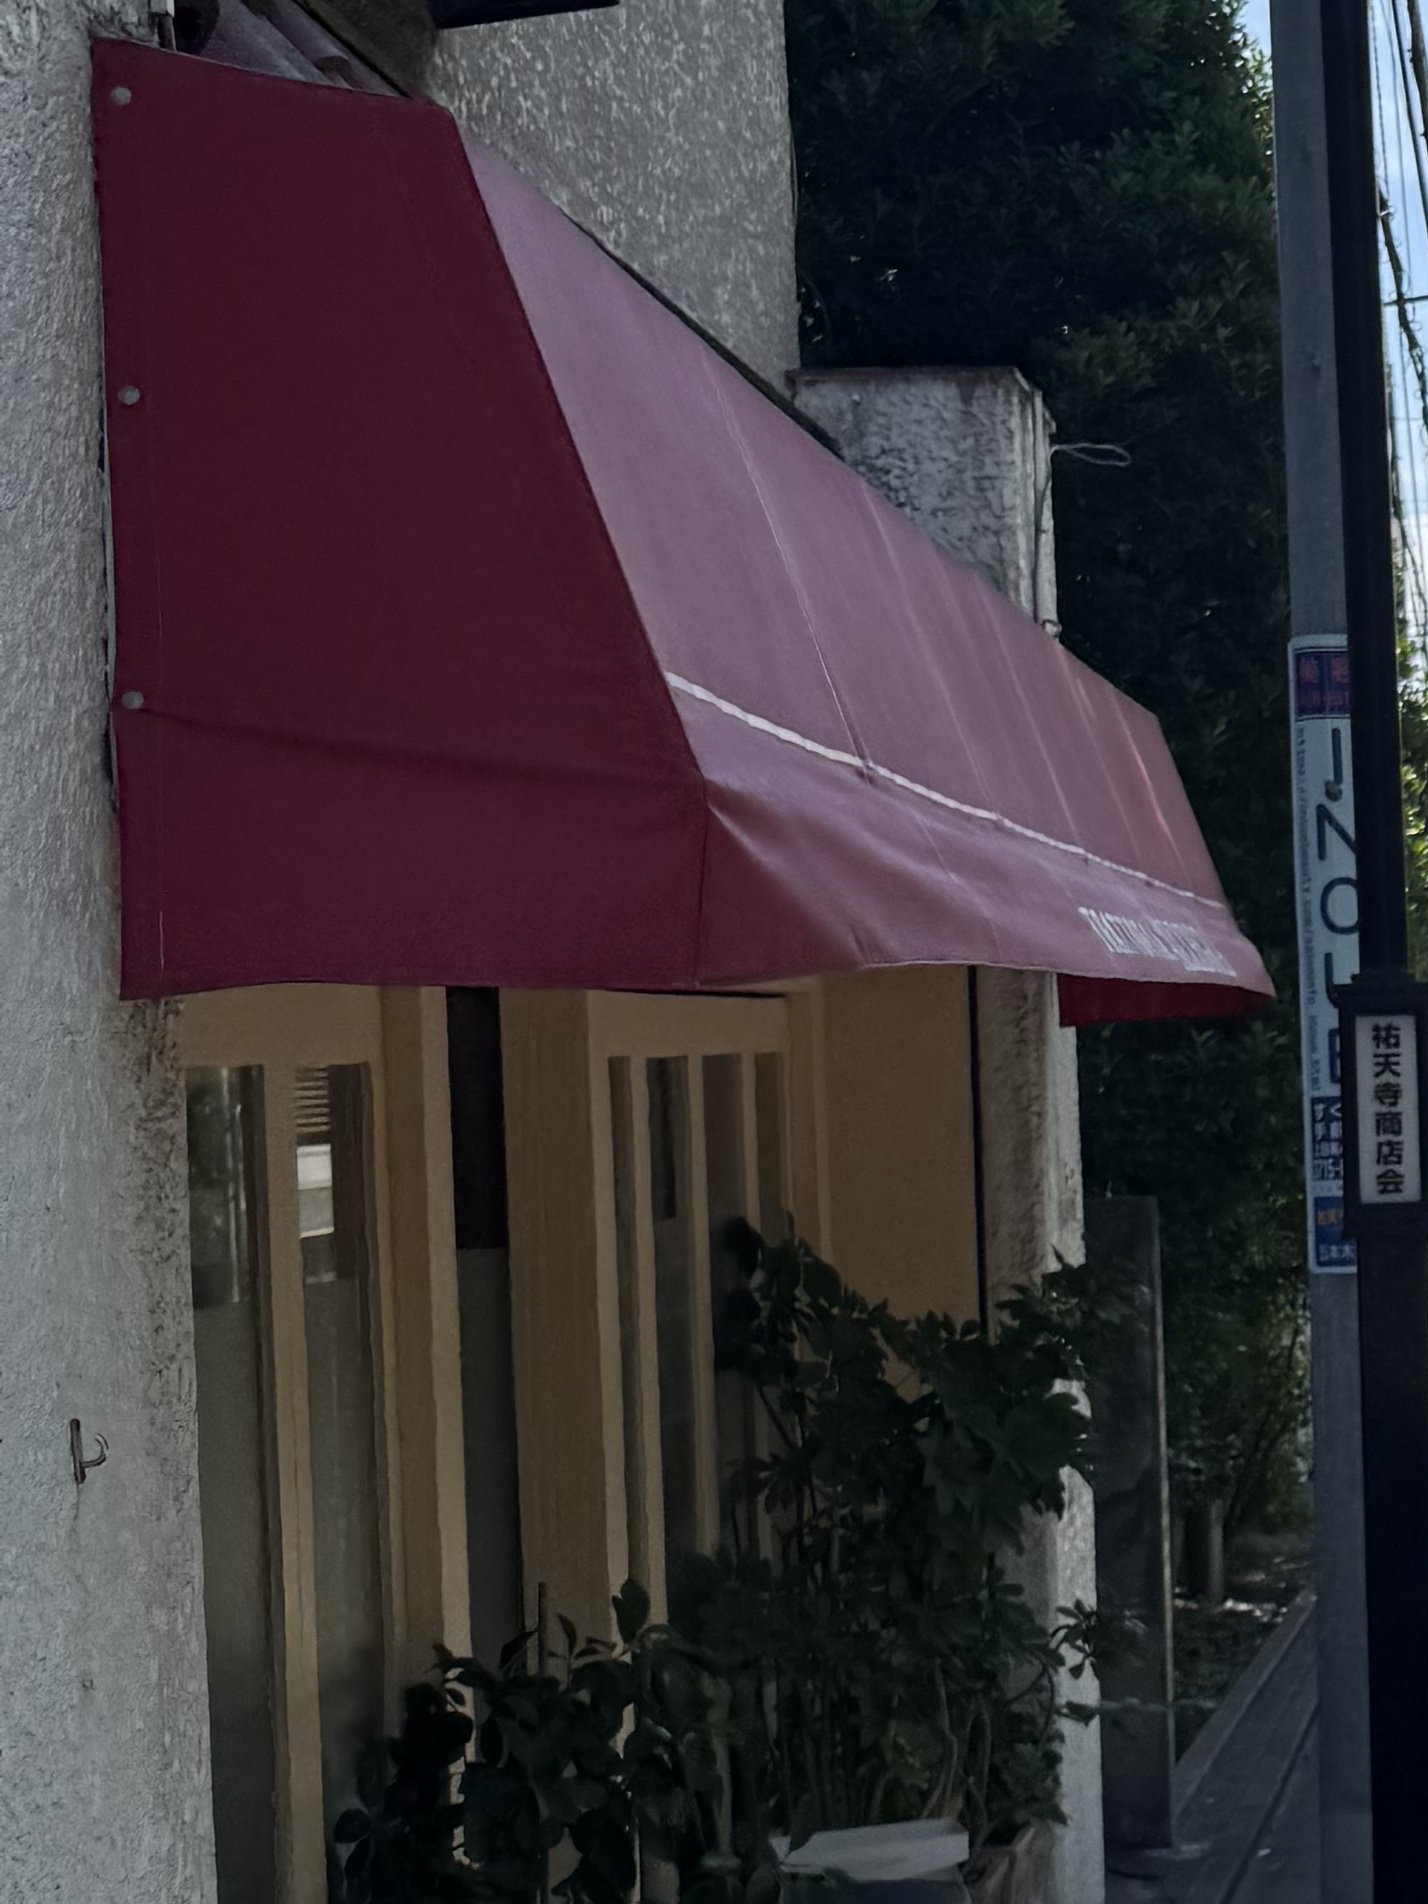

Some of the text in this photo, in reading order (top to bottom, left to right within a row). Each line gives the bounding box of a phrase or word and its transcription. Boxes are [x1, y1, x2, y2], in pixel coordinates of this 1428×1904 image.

[1372, 1023, 1405, 1195] 祐天寺商店会
